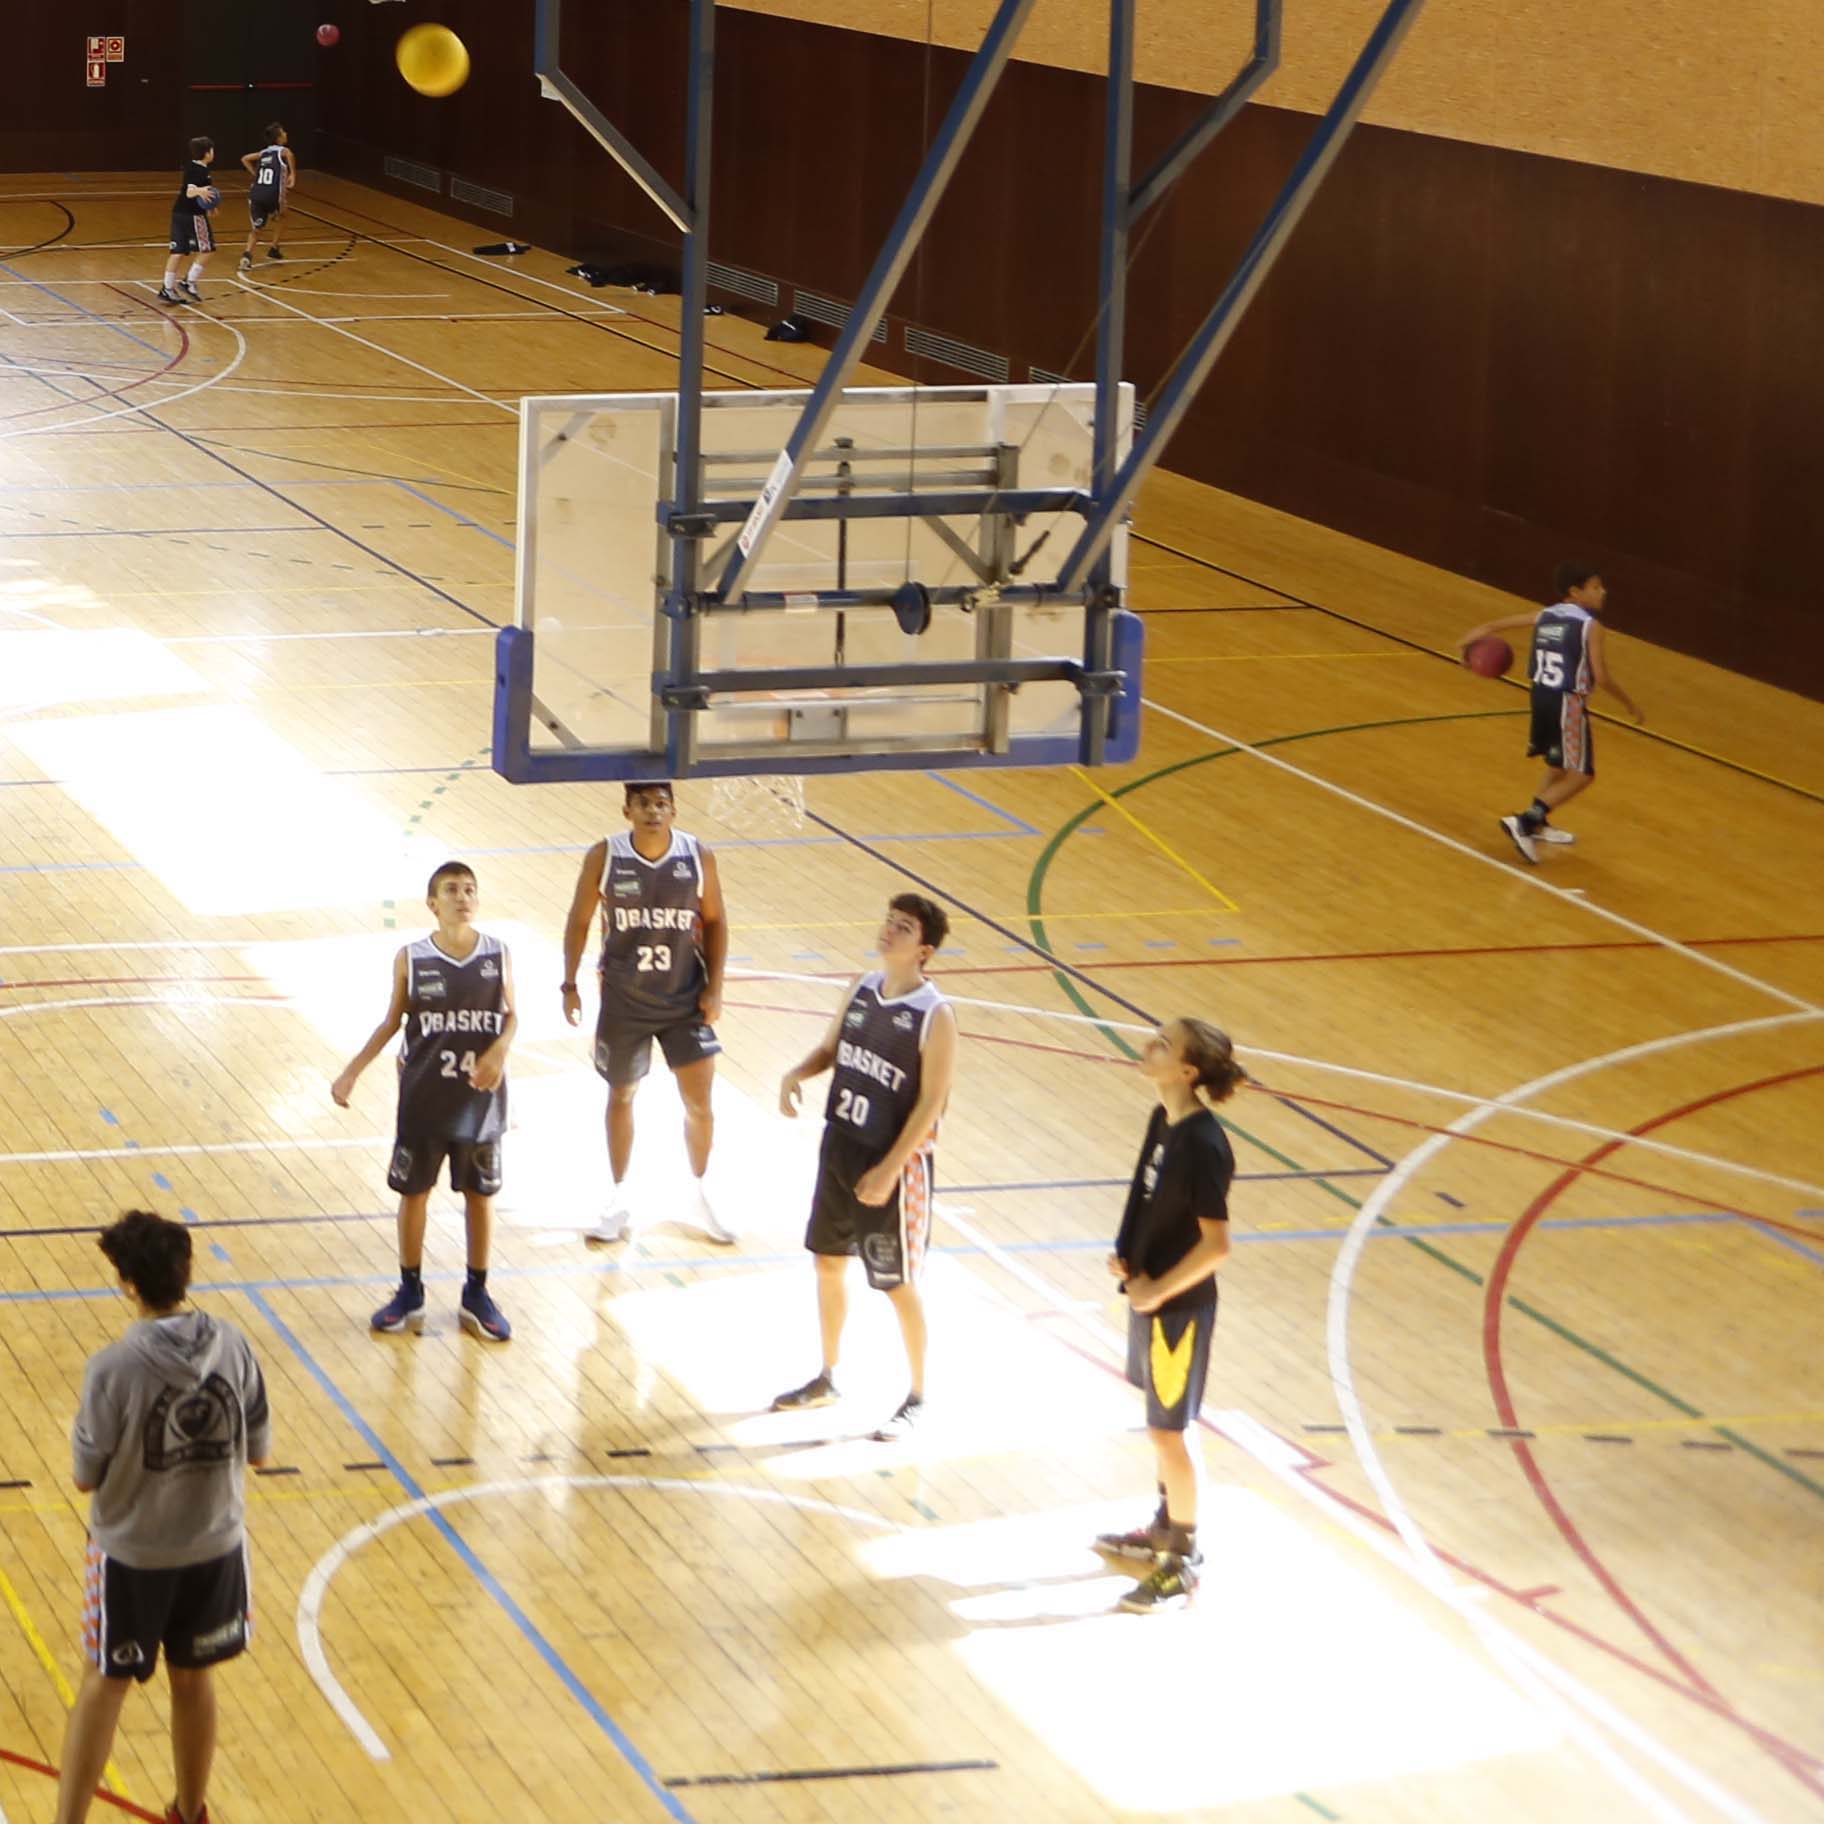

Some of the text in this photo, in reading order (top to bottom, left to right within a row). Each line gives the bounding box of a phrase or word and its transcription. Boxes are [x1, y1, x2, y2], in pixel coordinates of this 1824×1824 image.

[257, 168, 273, 184] 10
[1534, 649, 1565, 687] 15
[637, 945, 672, 972] 23
[440, 1050, 477, 1078] 24
[835, 1088, 870, 1127] 20
